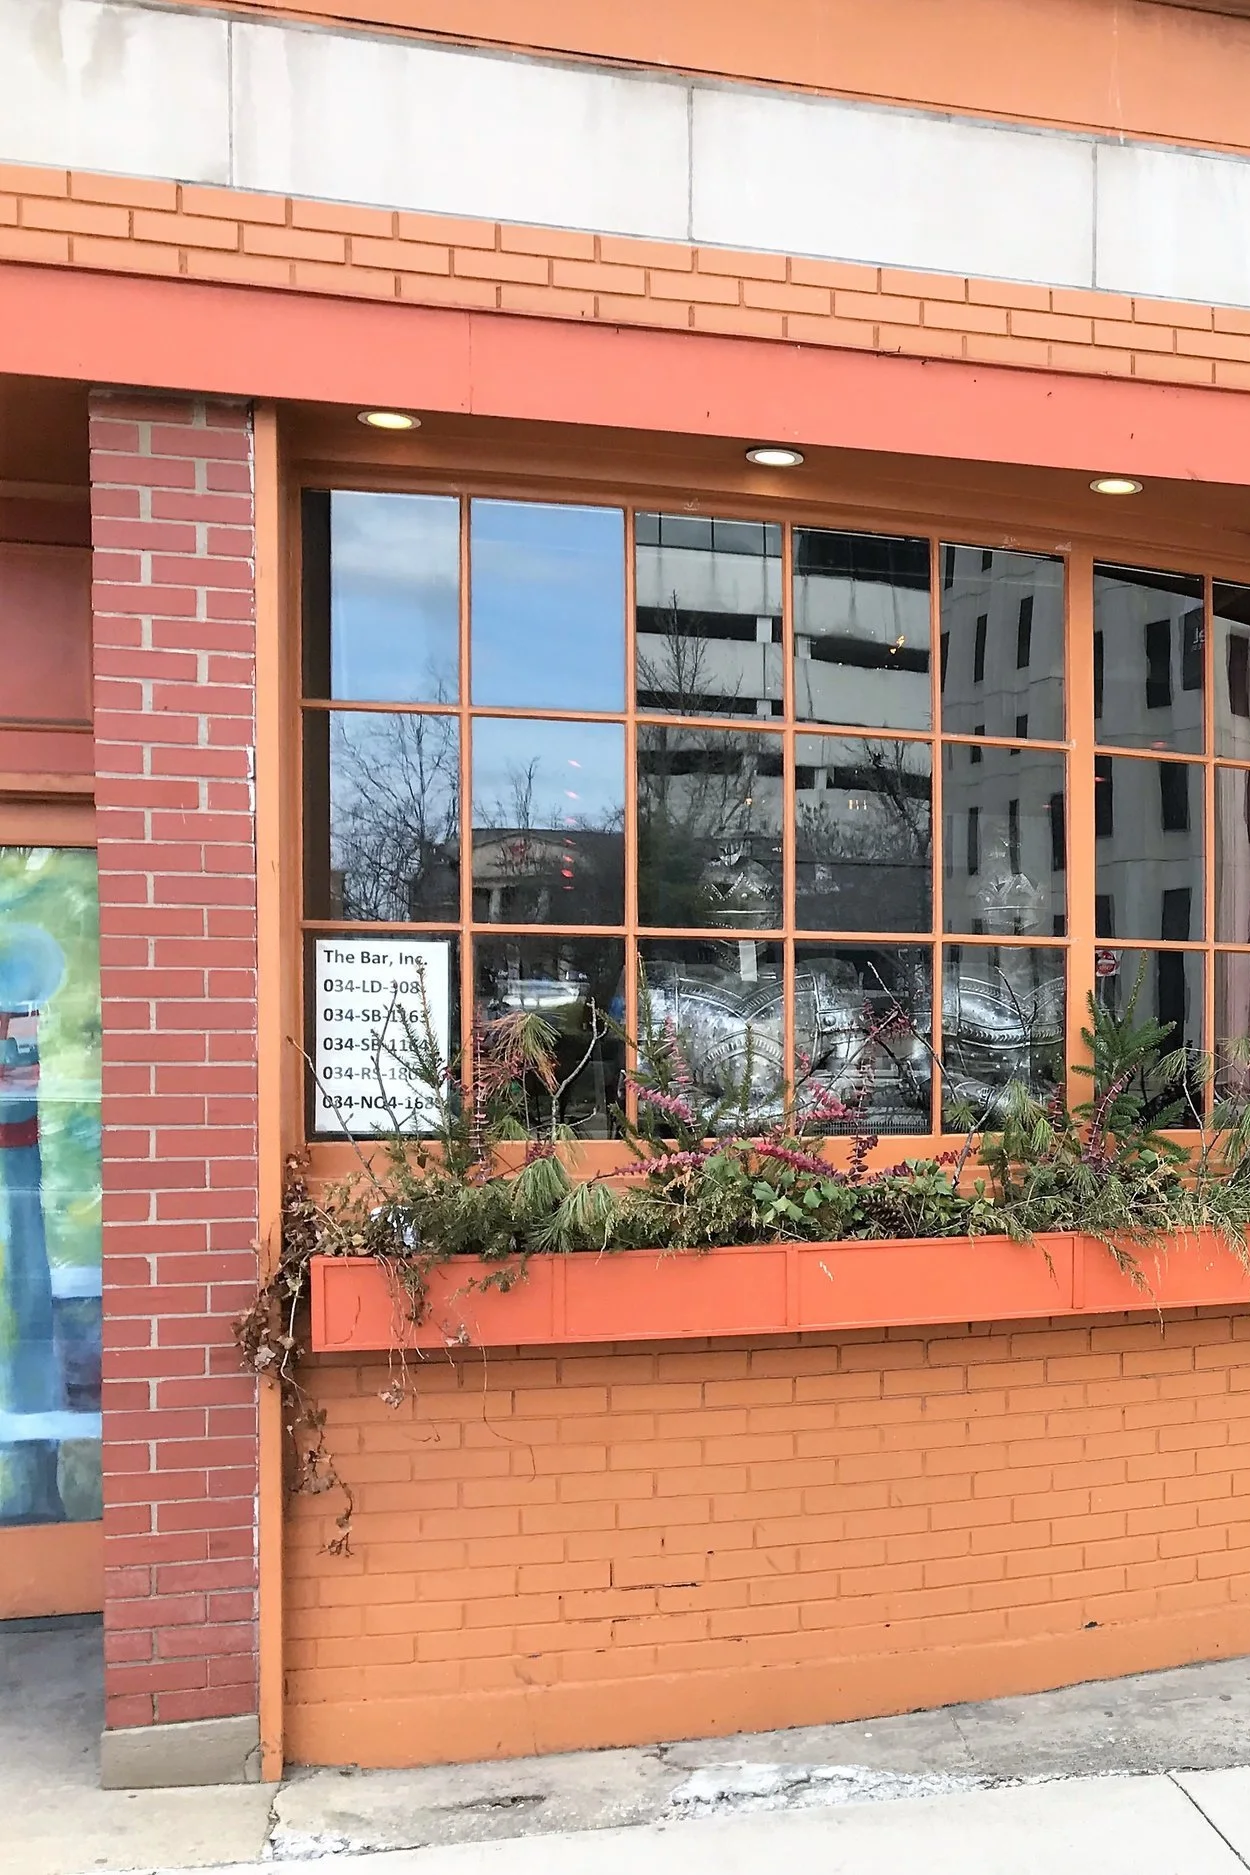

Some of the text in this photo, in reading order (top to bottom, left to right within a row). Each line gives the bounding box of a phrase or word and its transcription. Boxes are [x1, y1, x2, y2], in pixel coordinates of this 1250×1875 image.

[323, 949, 428, 967] The Bar, Inc.
